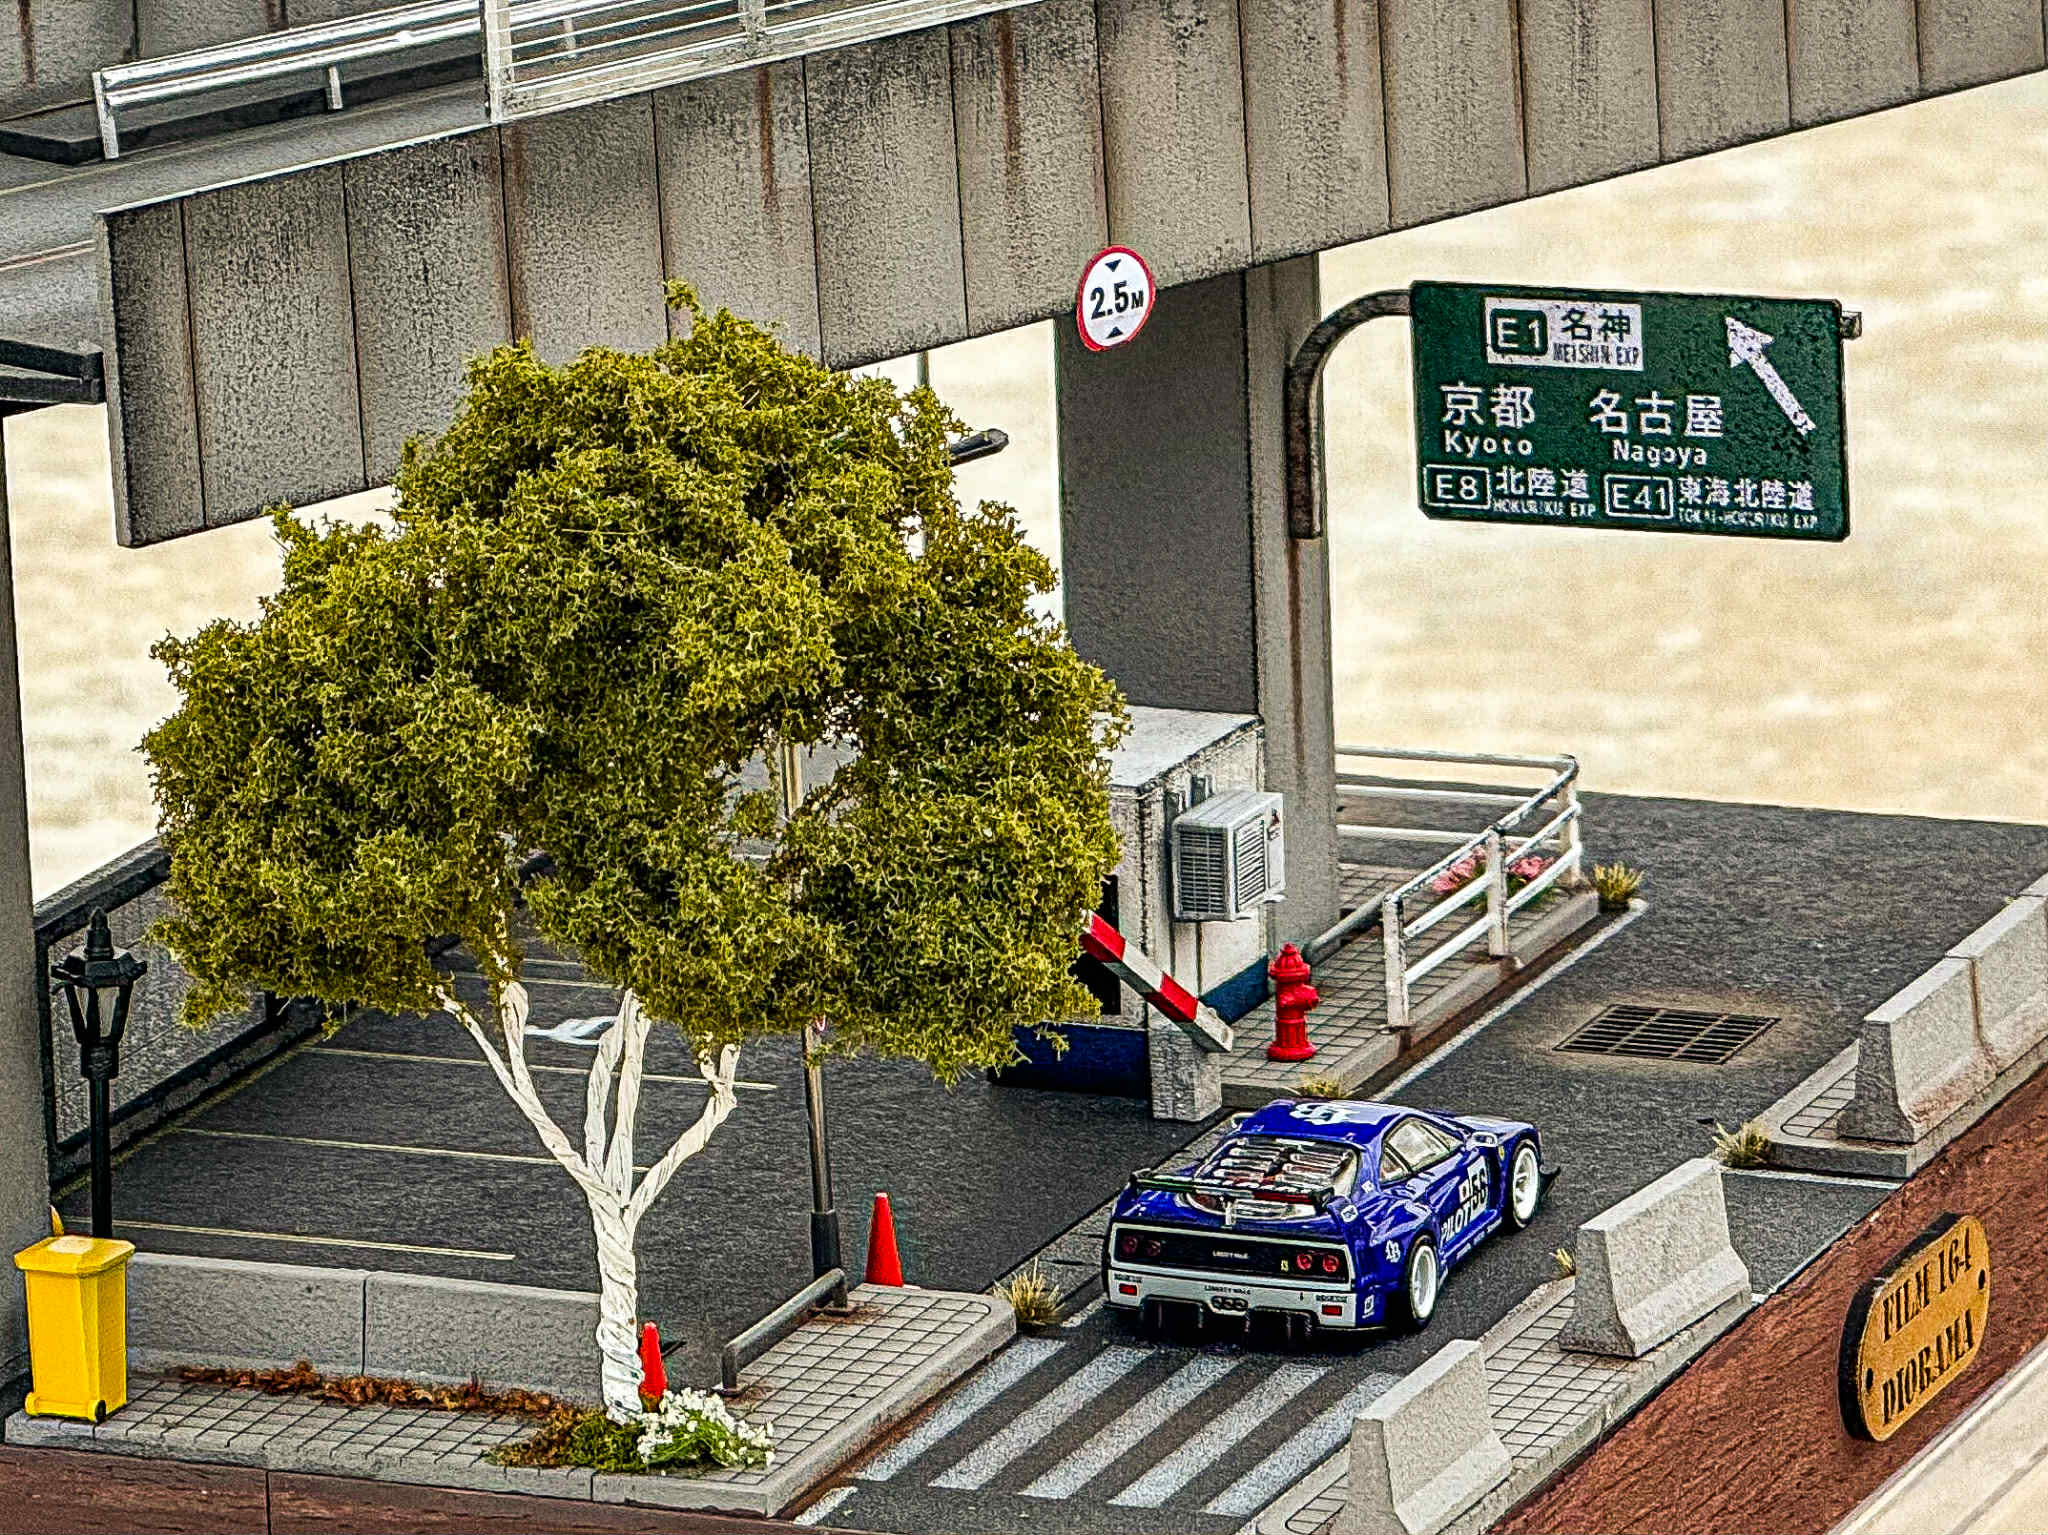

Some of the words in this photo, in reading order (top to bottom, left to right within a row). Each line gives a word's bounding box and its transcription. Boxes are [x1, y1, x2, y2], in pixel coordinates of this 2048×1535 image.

[1496, 317, 1541, 348] E1
[1560, 307, 1631, 342] 名神
[1552, 342, 1611, 364] MEISHIN
[1616, 345, 1640, 366] EXP
[1440, 381, 1536, 429] 京都
[1589, 388, 1724, 438] 名古屋
[1444, 429, 1534, 458] Kyoto
[1612, 439, 1708, 470] Nagoya
[1435, 474, 1479, 500] E8
[1495, 465, 1590, 499] 北陸道
[1612, 483, 1668, 511] E41
[1678, 474, 1816, 511] 東海北陸道
[1570, 502, 1597, 518] EXP
[1938, 1227, 1972, 1294] 164
[1882, 1309, 1974, 1425] DIORAMA
